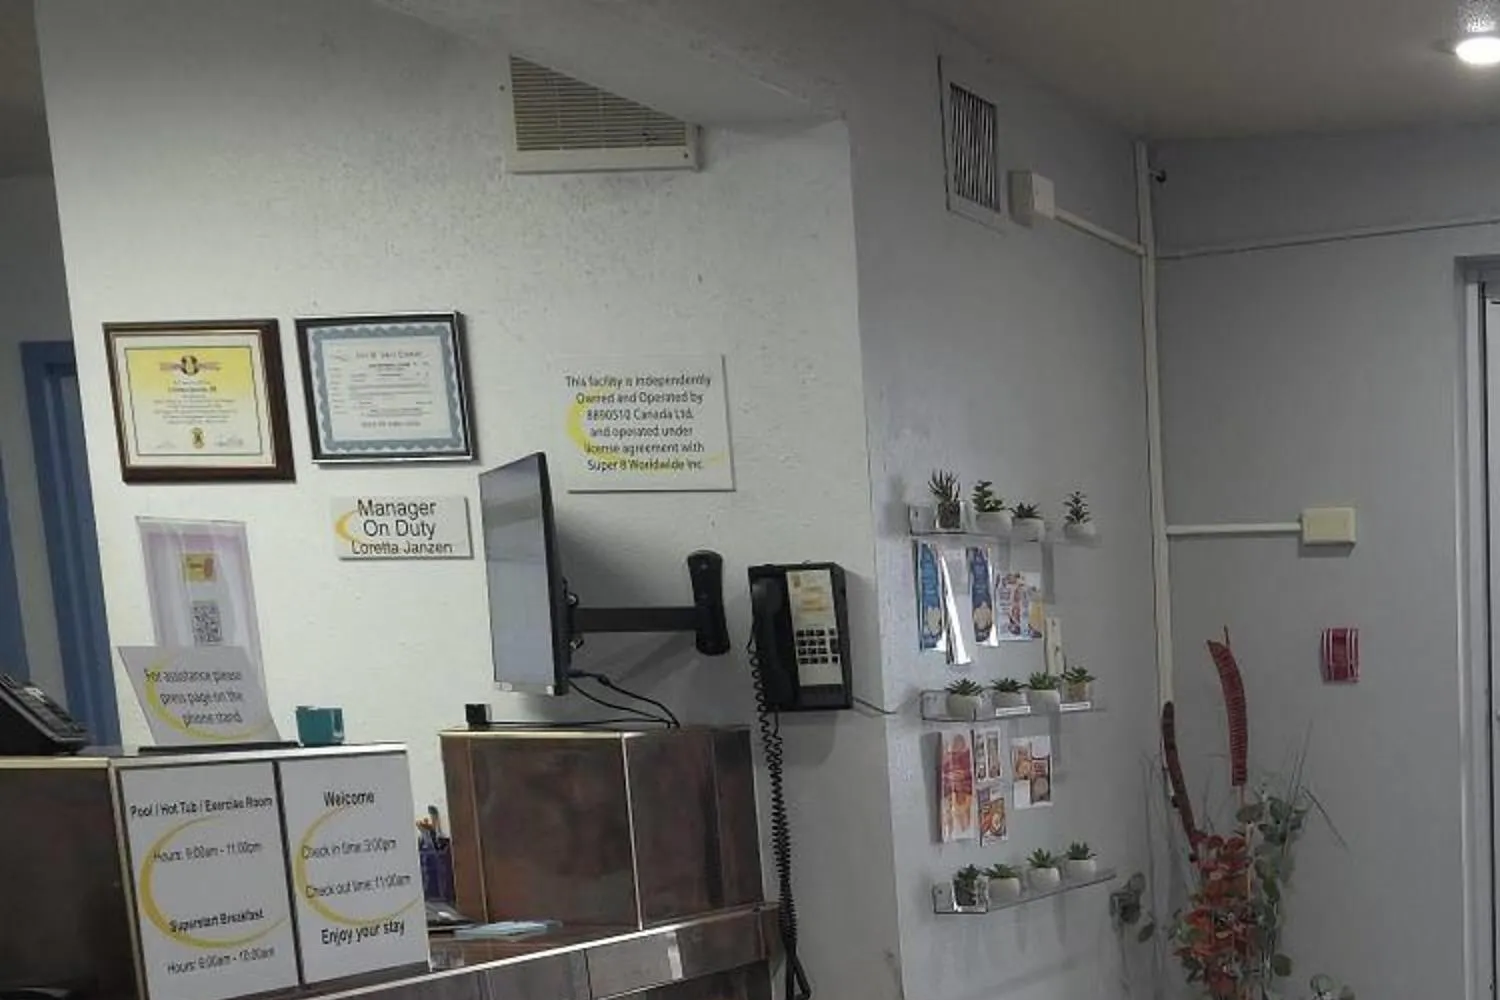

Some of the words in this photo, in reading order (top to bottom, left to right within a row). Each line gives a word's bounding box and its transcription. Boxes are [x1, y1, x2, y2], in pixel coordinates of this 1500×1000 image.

[565, 375, 586, 387] This
[587, 374, 623, 389] facility
[635, 373, 711, 388] independently
[576, 392, 615, 404] Owned
[617, 391, 637, 402] and
[639, 391, 689, 405] Operated
[690, 391, 704, 405] by
[633, 408, 673, 420] Canada
[590, 427, 611, 437] and
[612, 426, 659, 439] operated
[661, 426, 694, 437] under
[622, 442, 679, 456] agreement
[681, 440, 705, 453] with
[587, 459, 618, 471] Super
[628, 458, 685, 470] Worldwide
[357, 499, 437, 520] Manager
[363, 519, 389, 537] On
[395, 519, 436, 540] Duty
[351, 540, 399, 555] Loretta
[403, 541, 453, 555] Janzen
[323, 790, 375, 807] Welcome
[130, 803, 153, 818] Pool
[160, 803, 178, 816] Hot
[179, 801, 197, 814] Tub
[204, 798, 245, 812] Exercise
[246, 796, 273, 808] Room
[219, 908, 265, 925] Breakfast
[321, 926, 353, 946] Enjoy
[355, 923, 381, 942] your
[383, 919, 405, 937] stay
